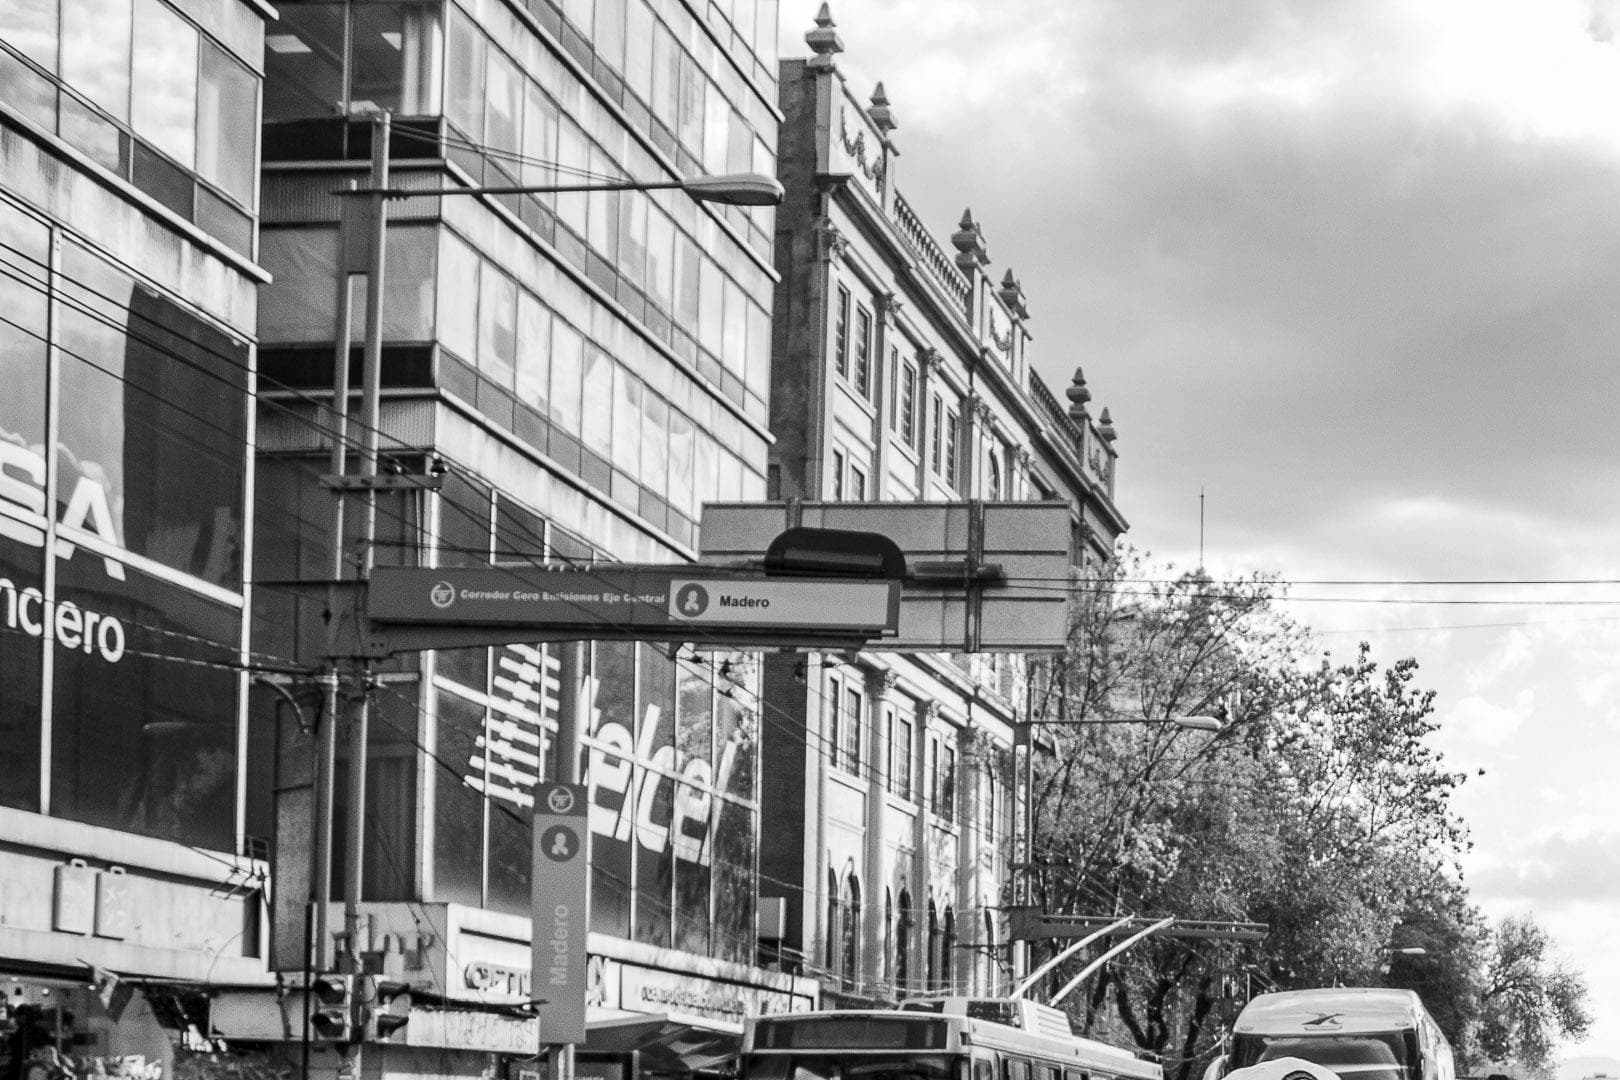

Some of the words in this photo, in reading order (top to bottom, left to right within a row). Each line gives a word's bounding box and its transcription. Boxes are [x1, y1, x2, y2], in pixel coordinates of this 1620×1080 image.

[0, 578, 125, 662] ncero
[720, 595, 770, 608] Madero
[549, 904, 569, 985] Madero
